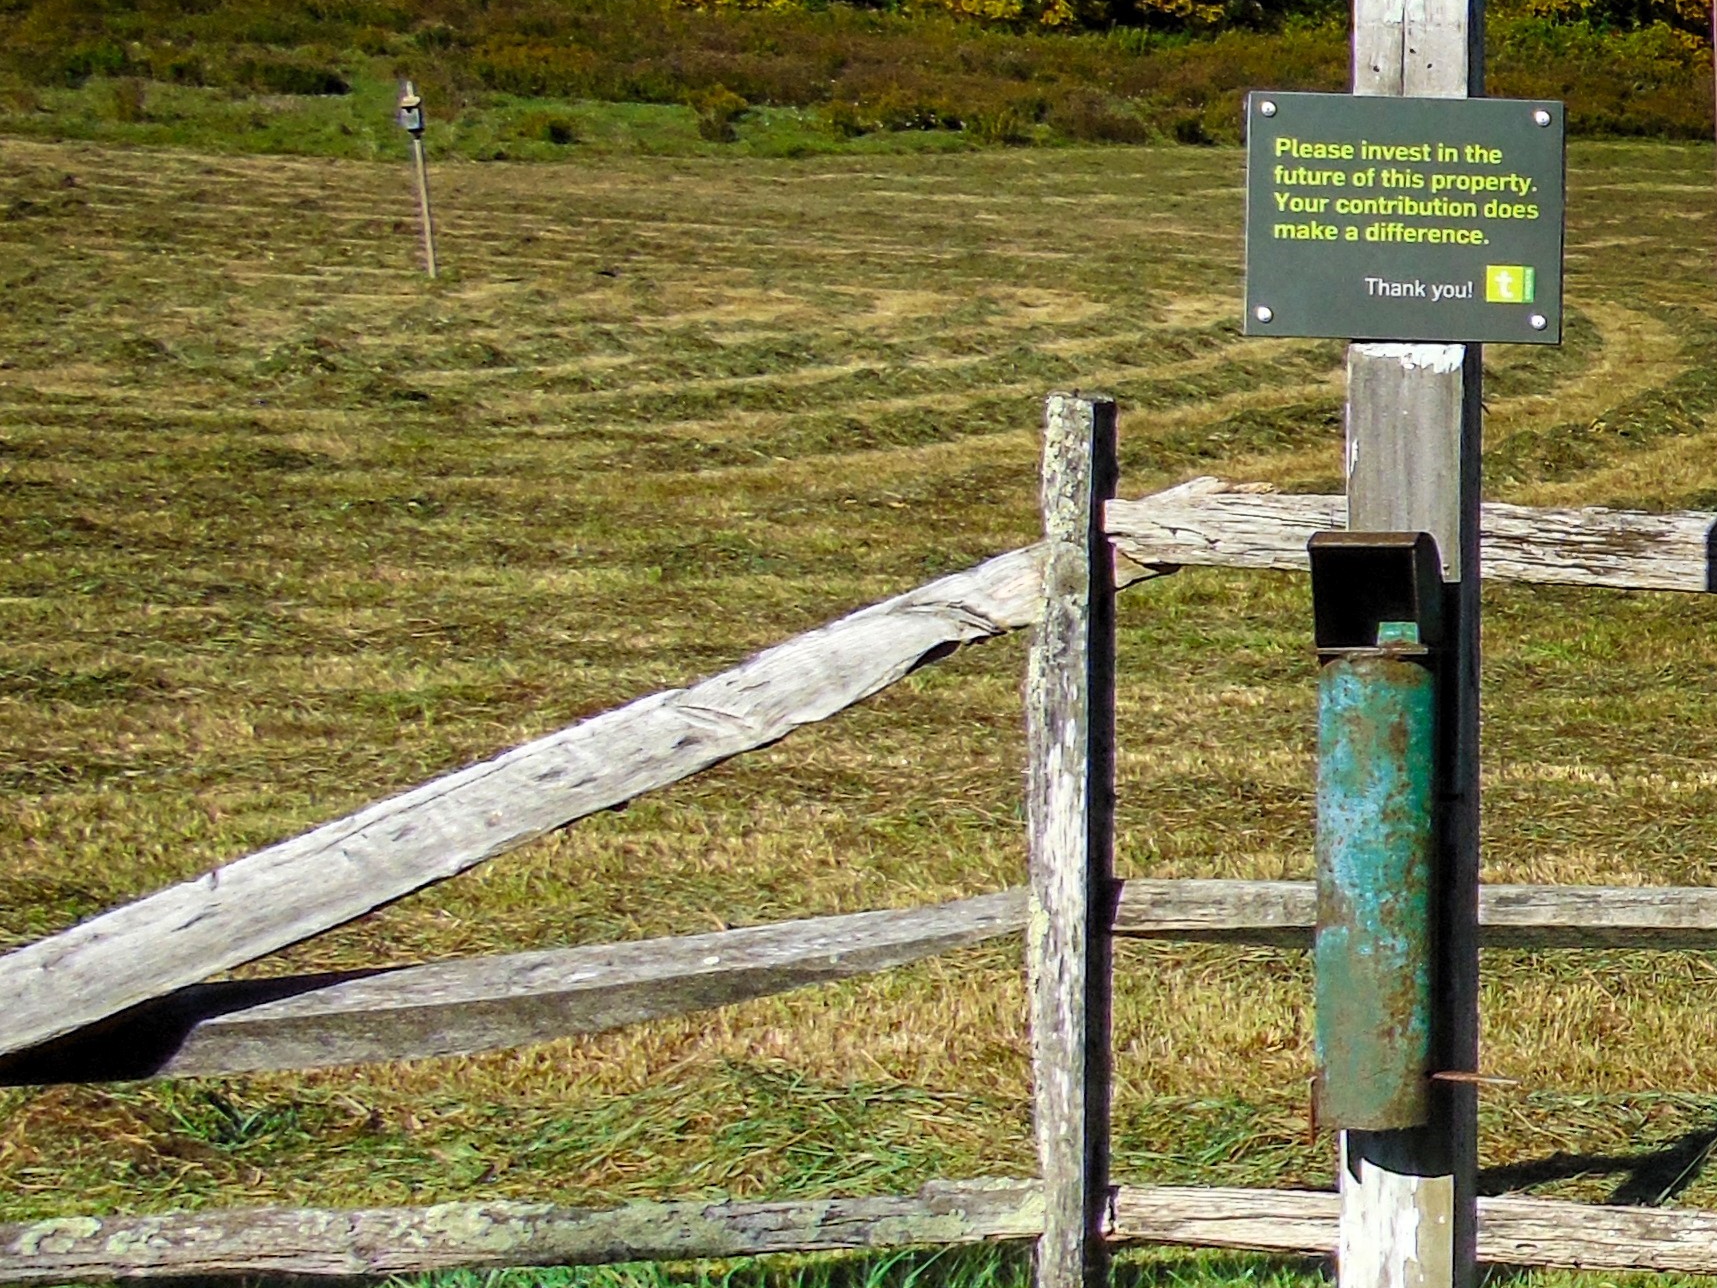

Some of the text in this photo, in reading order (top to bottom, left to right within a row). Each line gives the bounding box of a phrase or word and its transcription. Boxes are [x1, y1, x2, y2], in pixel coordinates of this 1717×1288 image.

[1275, 137, 1502, 163] Please invest in the
[1274, 166, 1537, 196] future of this property.
[1273, 192, 1538, 218] Your contribution does
[1274, 223, 1489, 244] make a difference.
[1364, 277, 1472, 301] Thank you!
